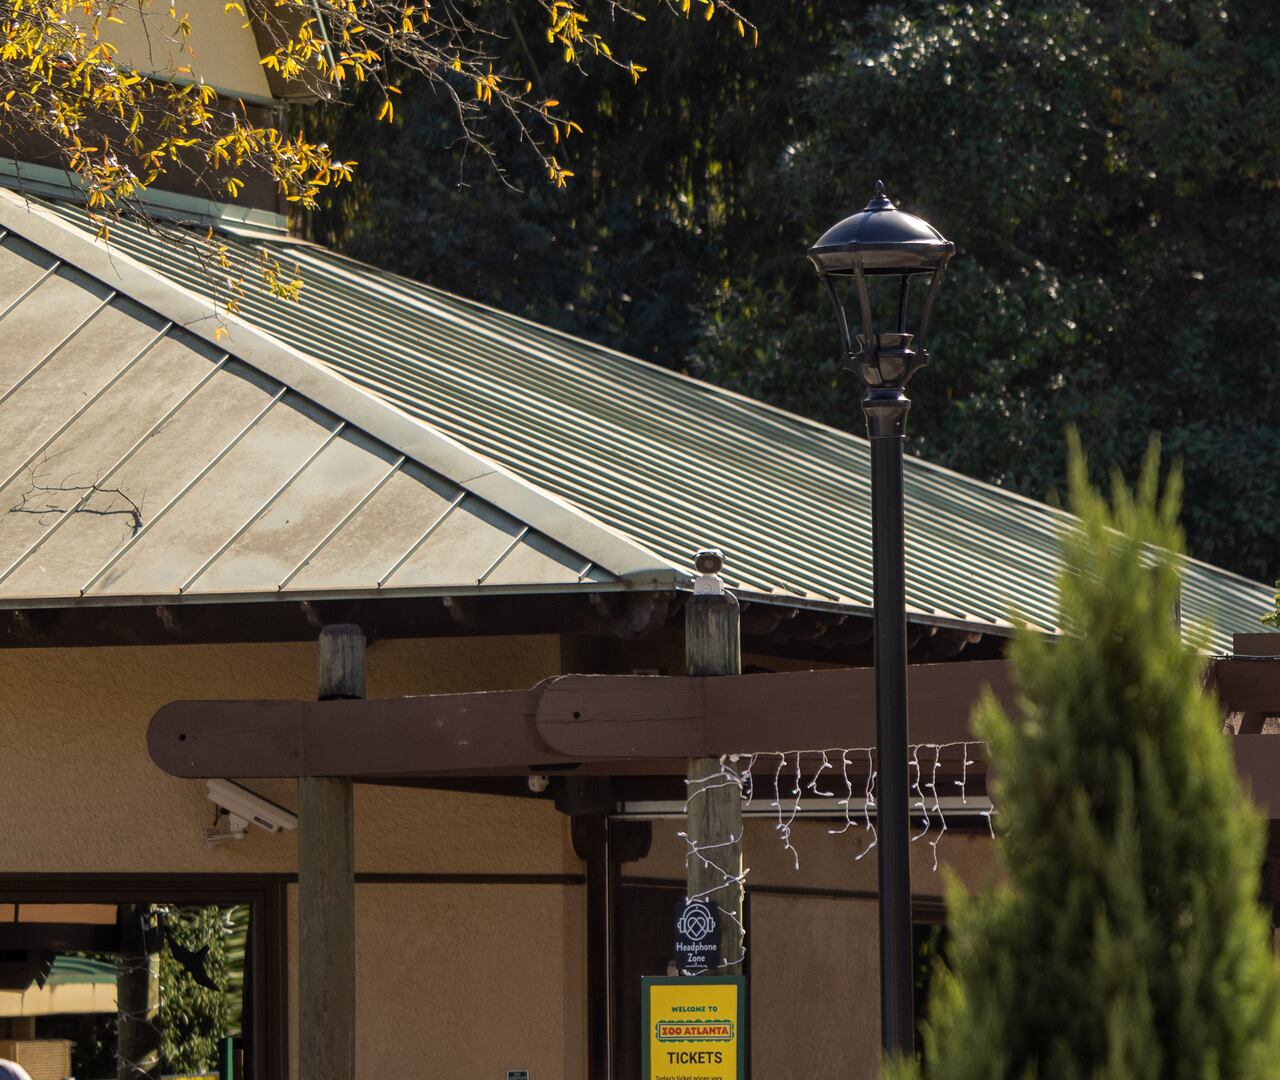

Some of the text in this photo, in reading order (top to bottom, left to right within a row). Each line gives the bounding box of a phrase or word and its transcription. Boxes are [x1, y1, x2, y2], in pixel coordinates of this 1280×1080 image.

[676, 942, 717, 954] Headphone
[688, 954, 706, 962] Zone
[662, 1026, 729, 1035] ZOO ATLANTA
[667, 1052, 722, 1064] TICKETS
